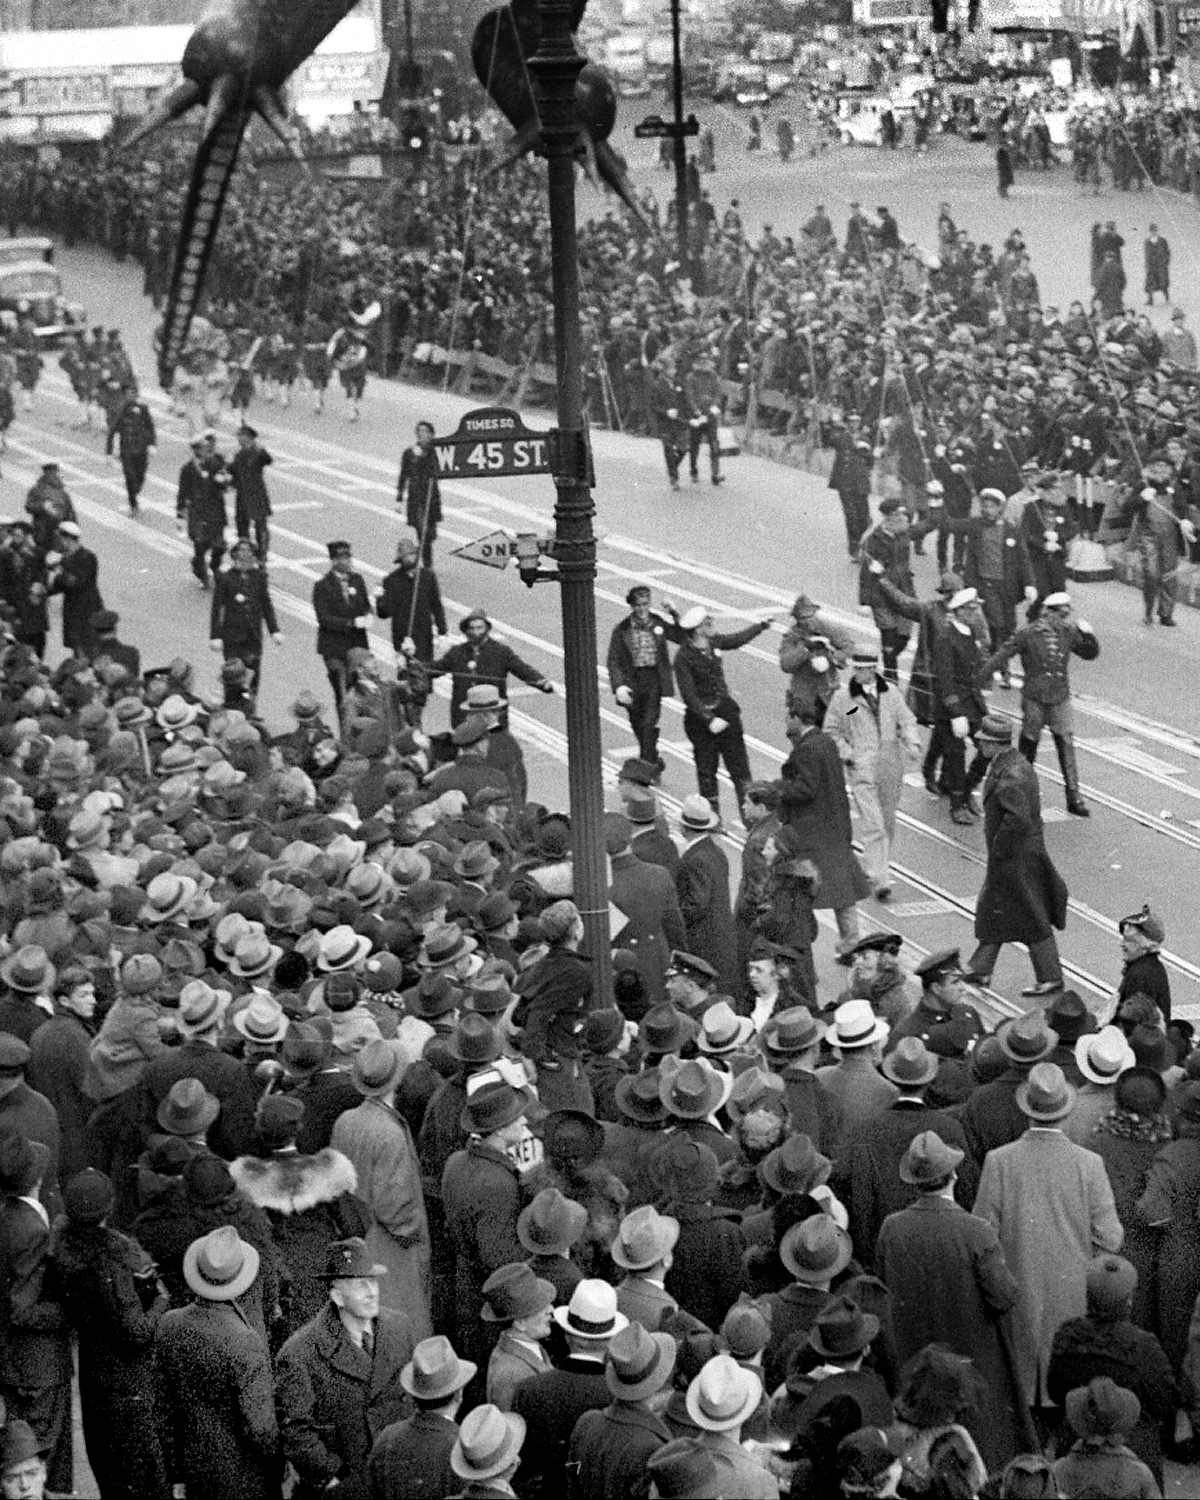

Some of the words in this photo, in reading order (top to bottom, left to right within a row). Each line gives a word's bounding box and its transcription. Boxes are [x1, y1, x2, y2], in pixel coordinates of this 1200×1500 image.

[466, 419, 498, 430] TIMES
[434, 445, 460, 471] W.
[467, 442, 504, 470] 45
[513, 440, 548, 467] ST.
[481, 543, 519, 558] ONE
